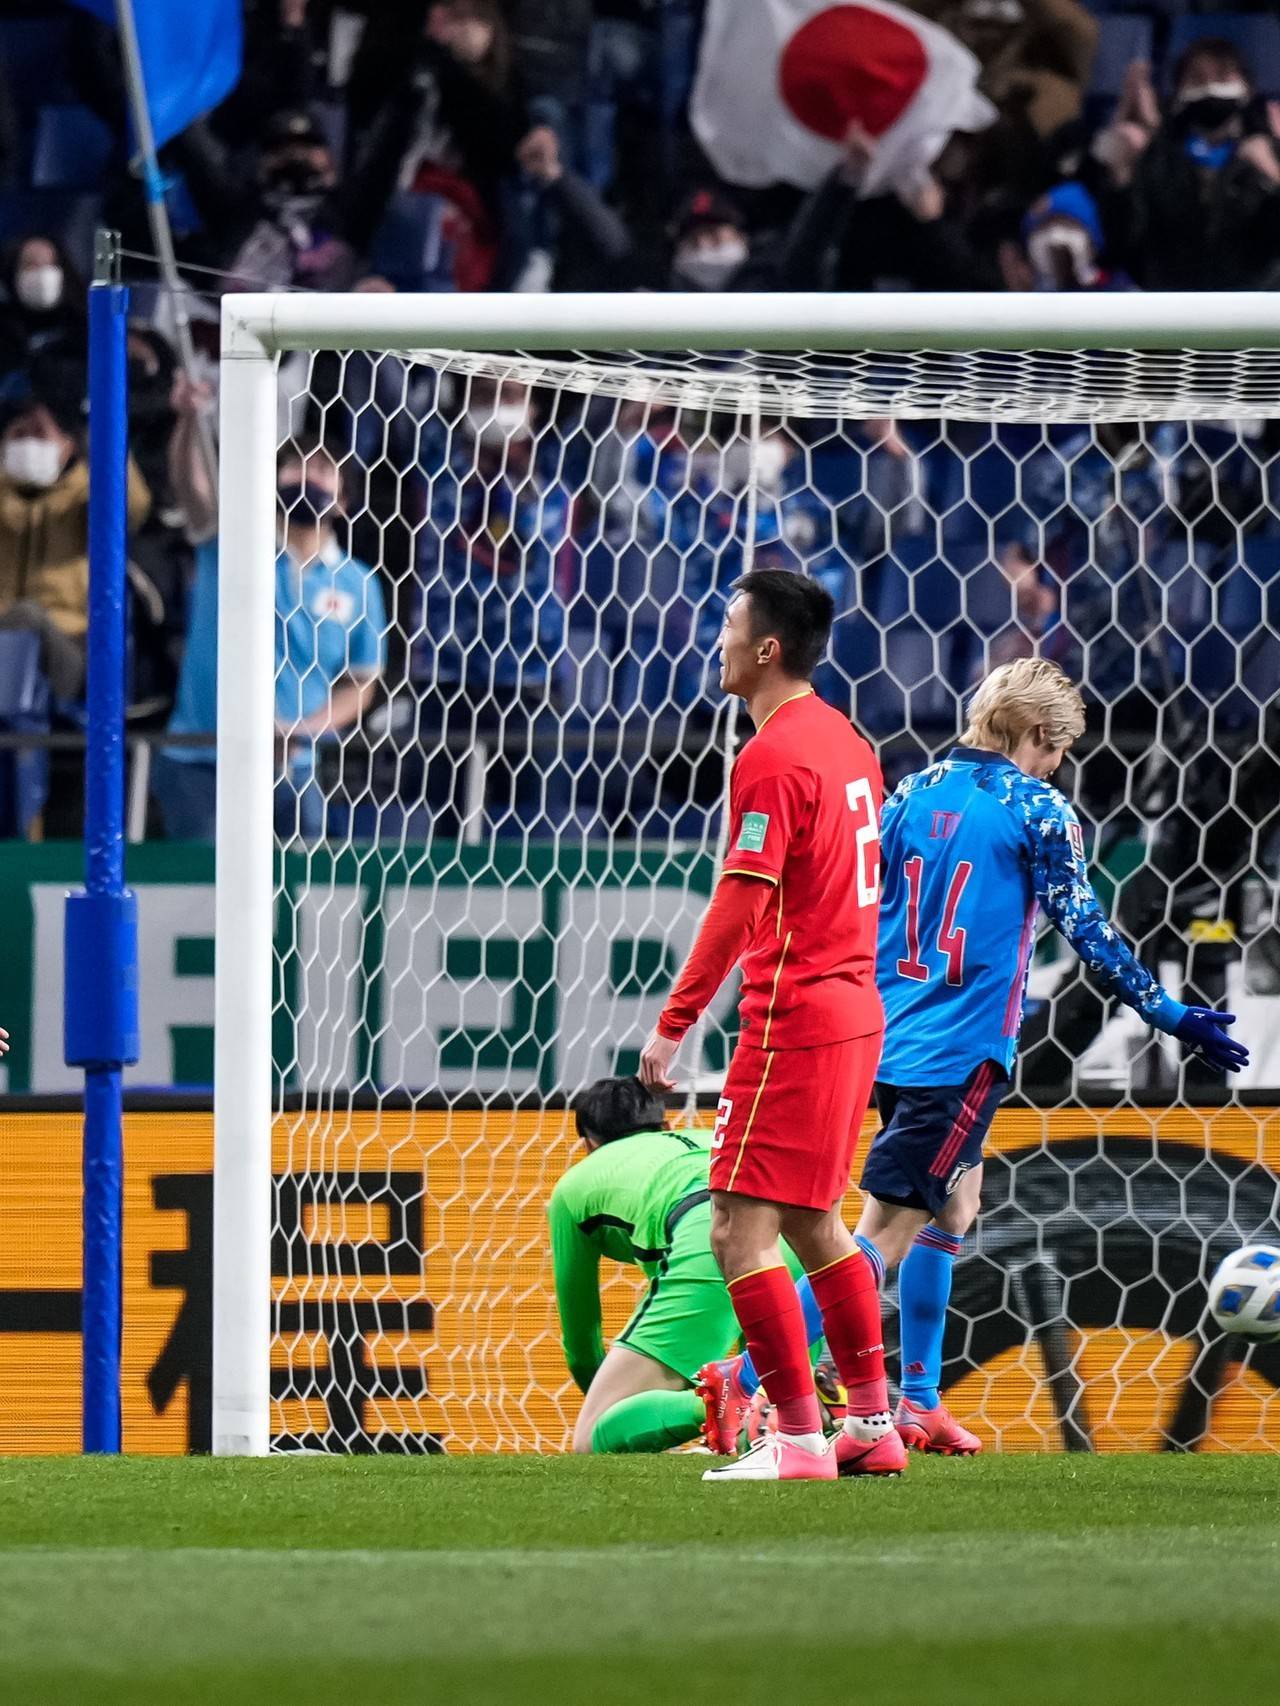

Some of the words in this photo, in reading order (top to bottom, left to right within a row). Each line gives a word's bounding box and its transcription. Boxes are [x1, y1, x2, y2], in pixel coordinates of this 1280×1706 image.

[846, 778, 880, 908] 2
[896, 856, 973, 986] 14
[712, 1097, 733, 1149] 2
